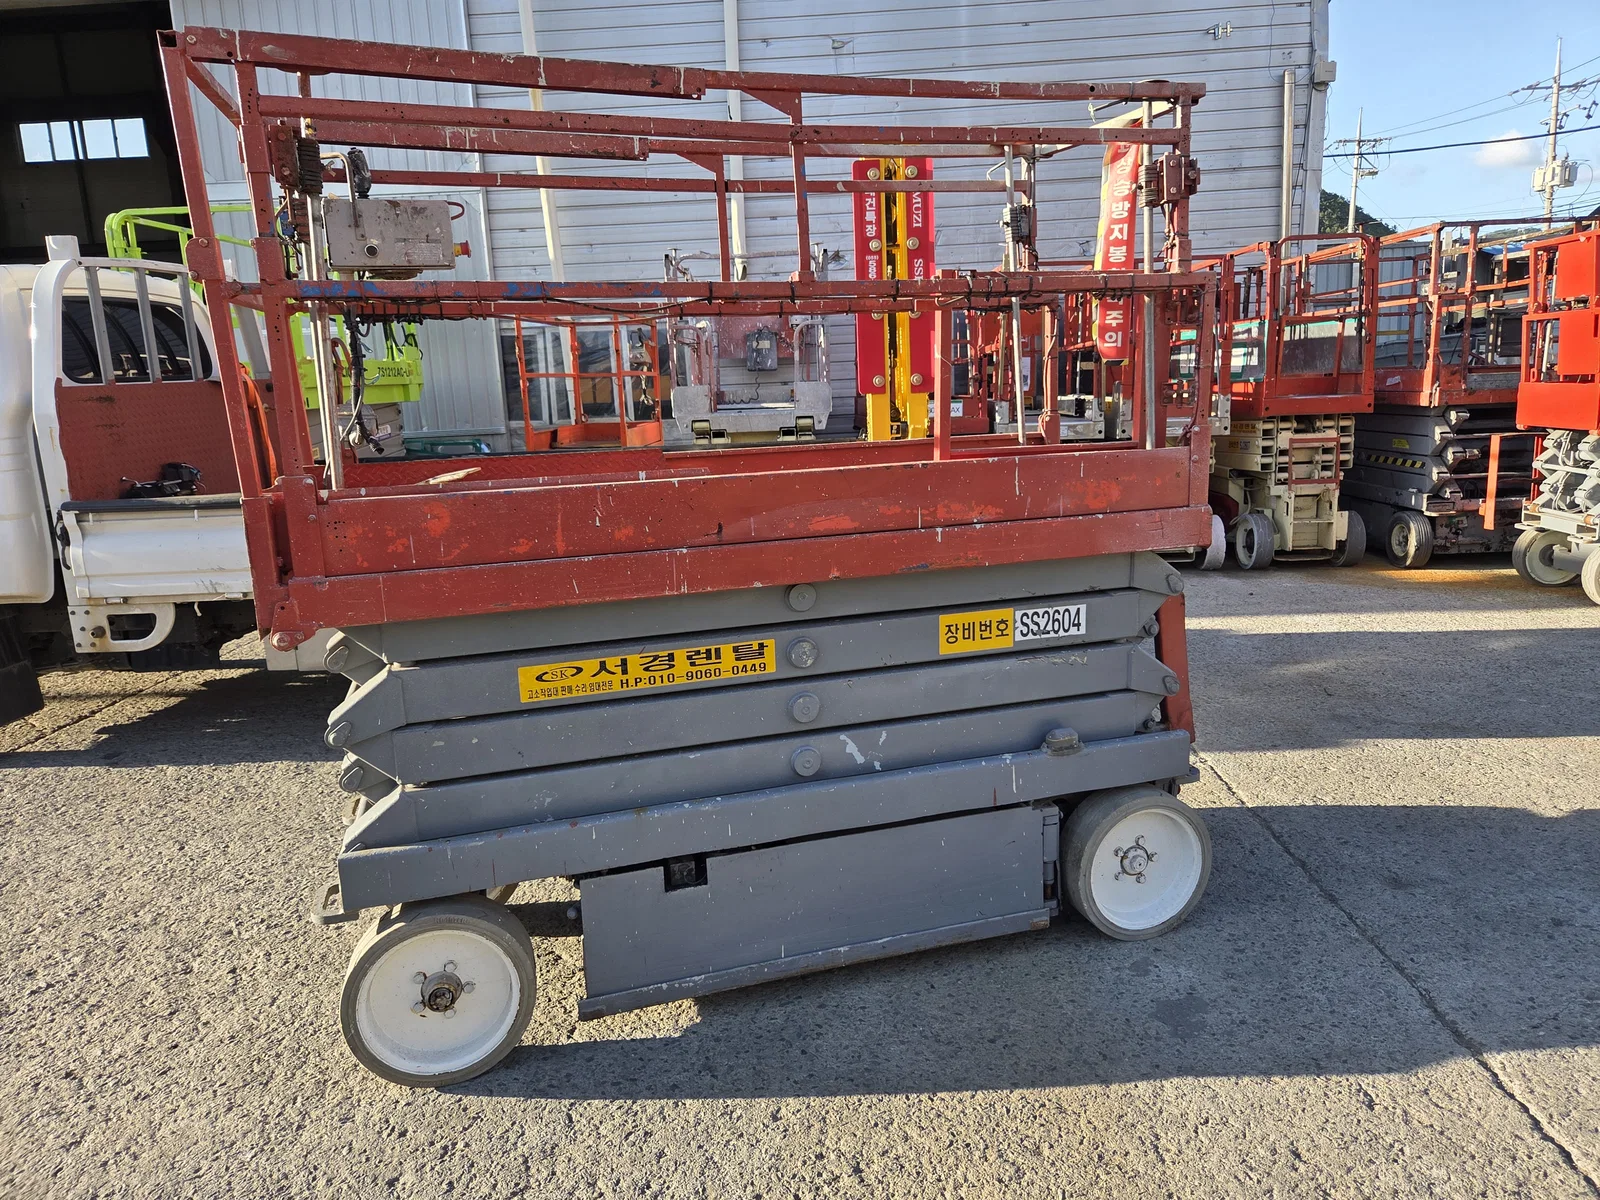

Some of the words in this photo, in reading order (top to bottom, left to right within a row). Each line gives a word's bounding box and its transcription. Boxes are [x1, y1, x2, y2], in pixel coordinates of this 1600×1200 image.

[944, 618, 1010, 645] 장비번호
[1020, 606, 1082, 638] SS2604
[589, 642, 769, 678] 서경렌탈
[550, 669, 569, 680] SK
[527, 686, 559, 700] 고소작업대
